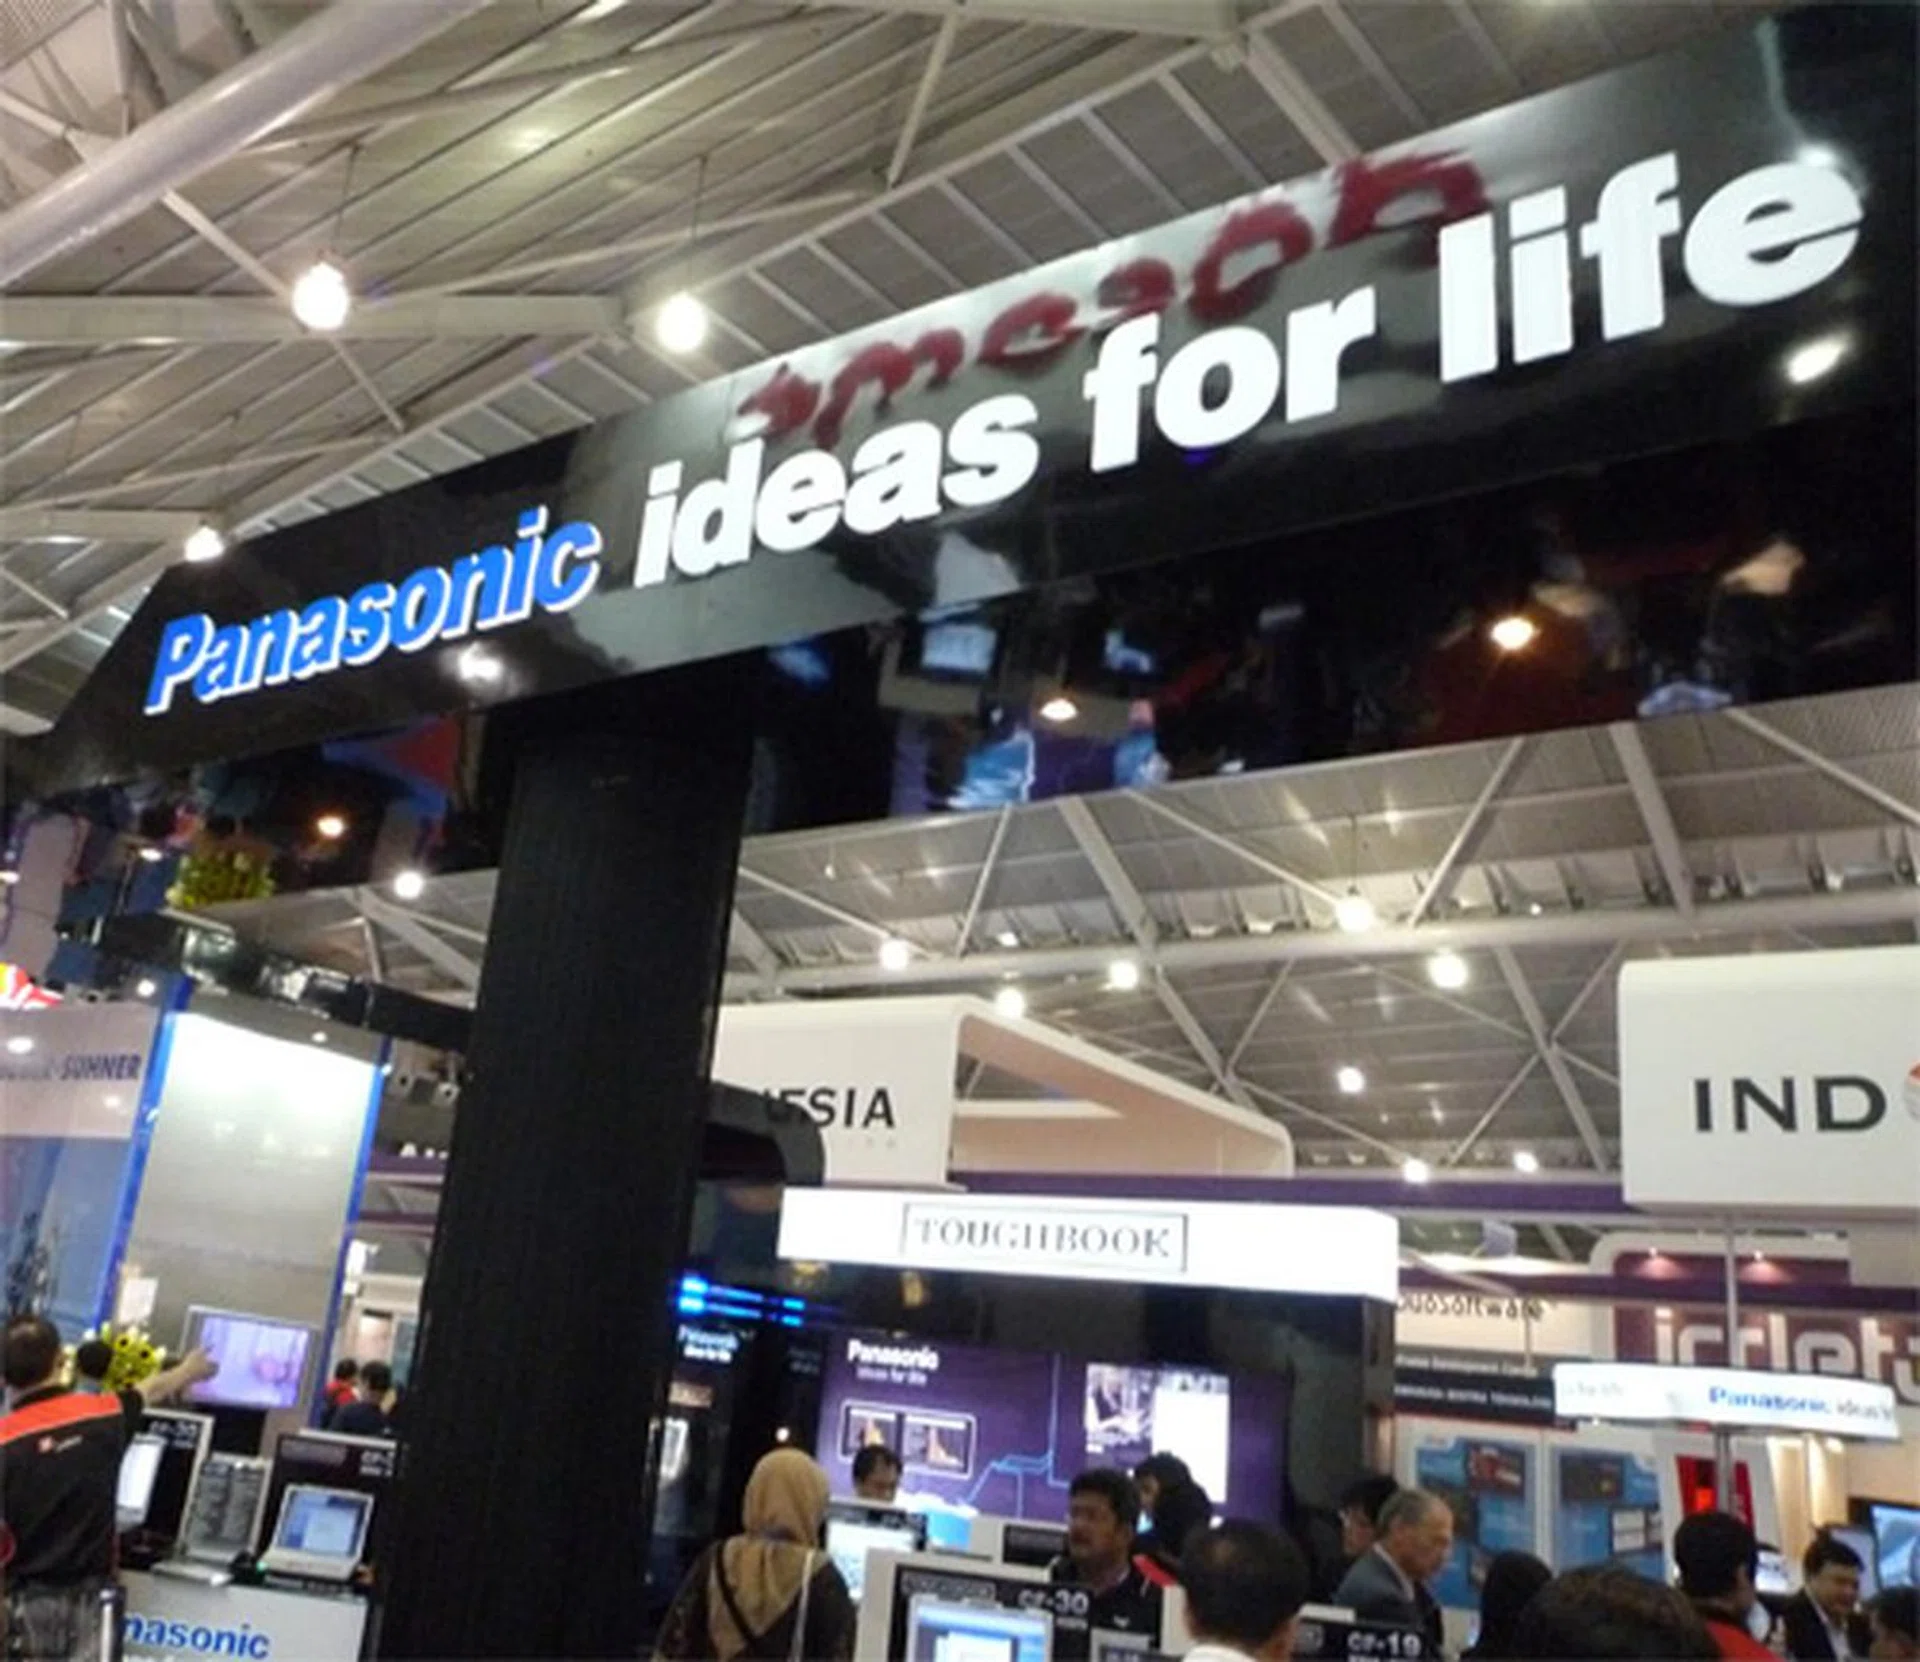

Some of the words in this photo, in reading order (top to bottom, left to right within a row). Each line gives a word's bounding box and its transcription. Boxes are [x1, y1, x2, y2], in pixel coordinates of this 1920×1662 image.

[144, 505, 602, 715] Panasonic
[634, 393, 1040, 588] ideas
[1083, 286, 1376, 473] for
[1438, 152, 1865, 384] life
[914, 1216, 1170, 1258] TOUGHBOOK
